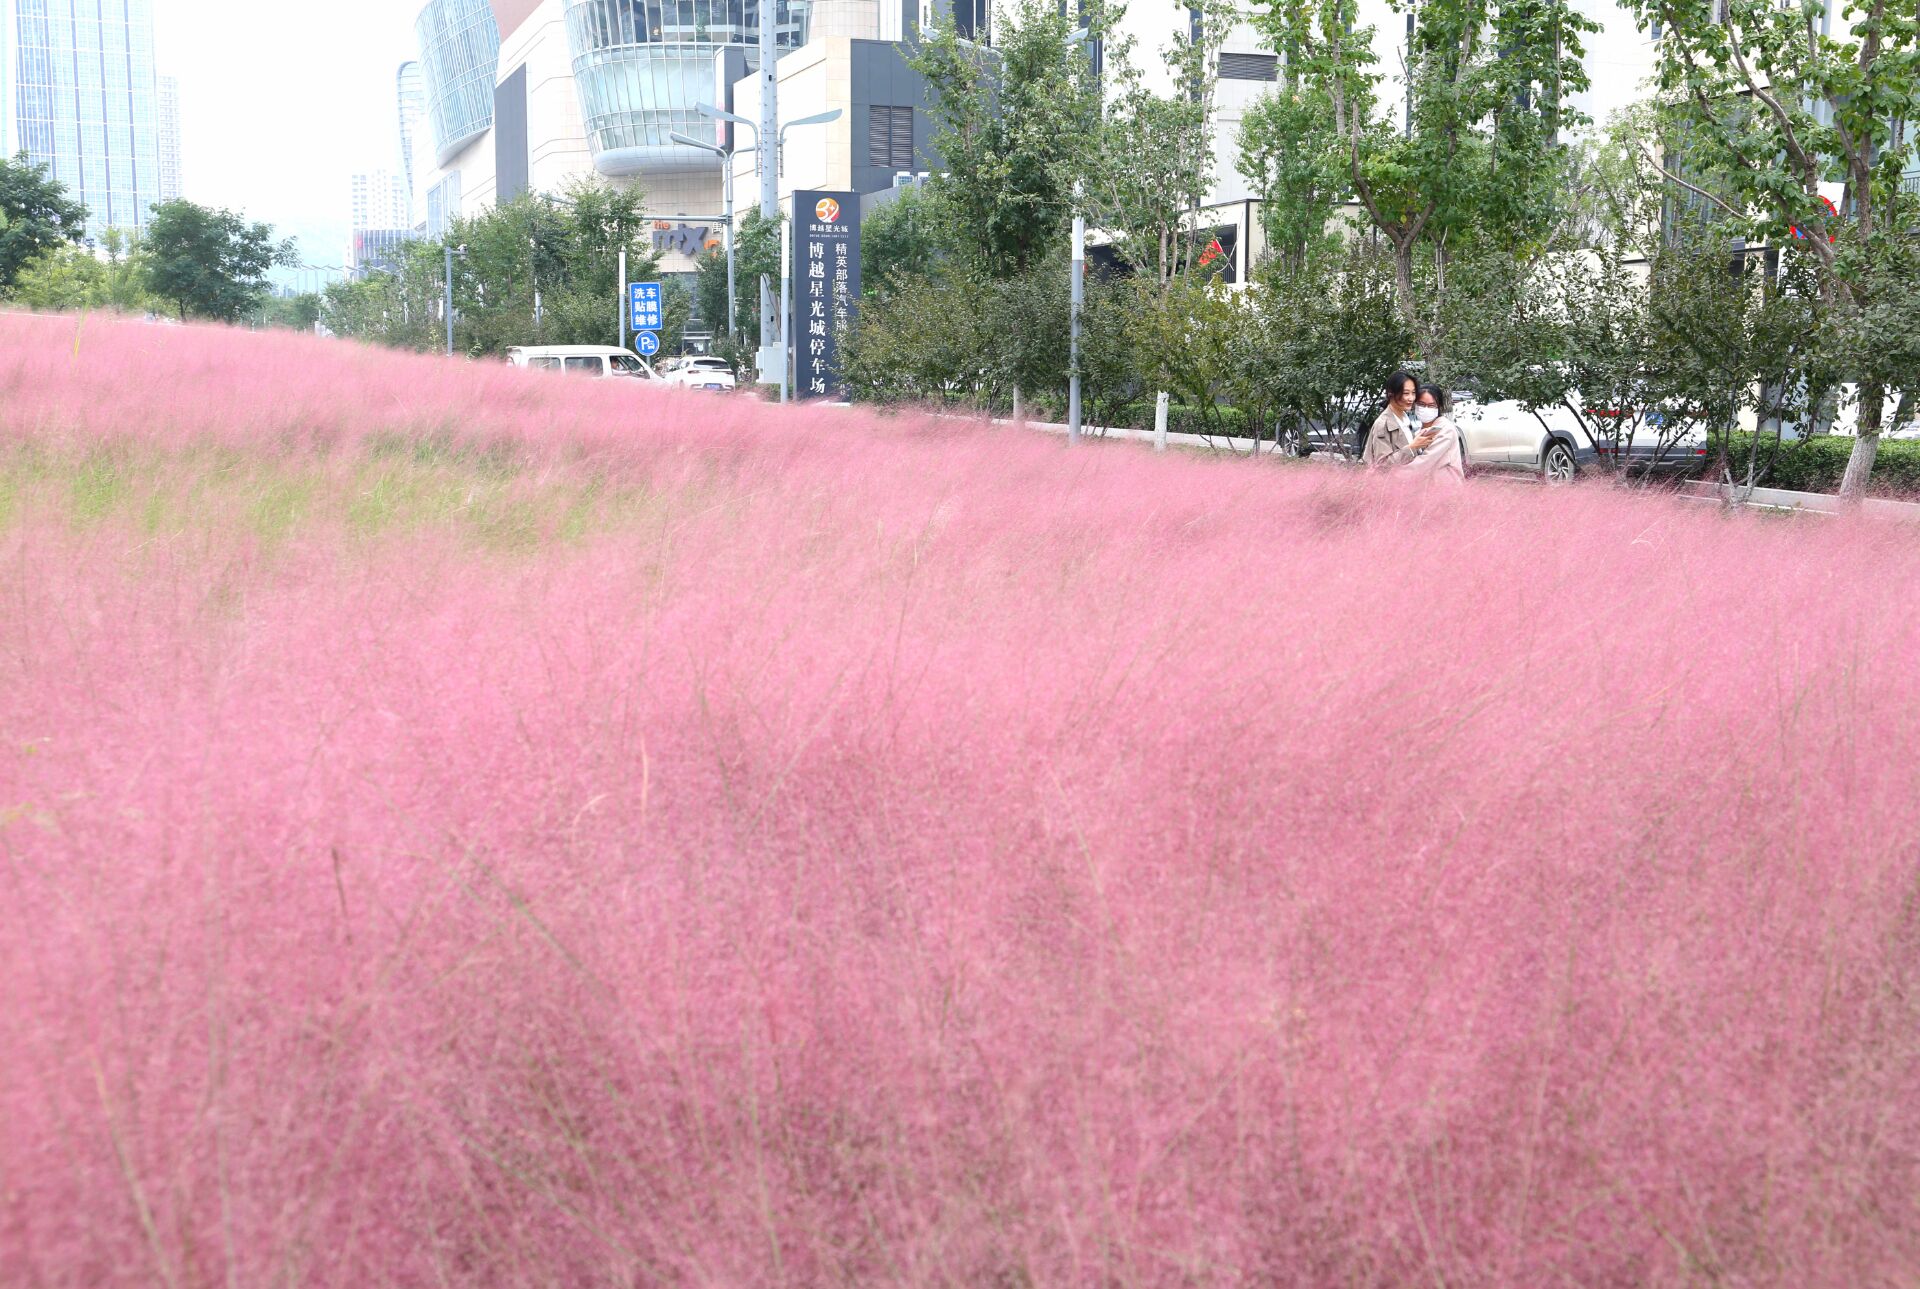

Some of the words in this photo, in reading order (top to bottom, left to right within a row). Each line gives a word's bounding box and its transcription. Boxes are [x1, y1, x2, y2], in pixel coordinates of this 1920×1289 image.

[653, 220, 670, 229] the
[809, 224, 849, 233] 博越星光城
[634, 287, 657, 299] 洗车
[634, 300, 658, 313] 贴膜
[635, 313, 659, 326] 维修
[808, 241, 826, 394] 博越星光城停车场
[641, 336, 650, 351] P
